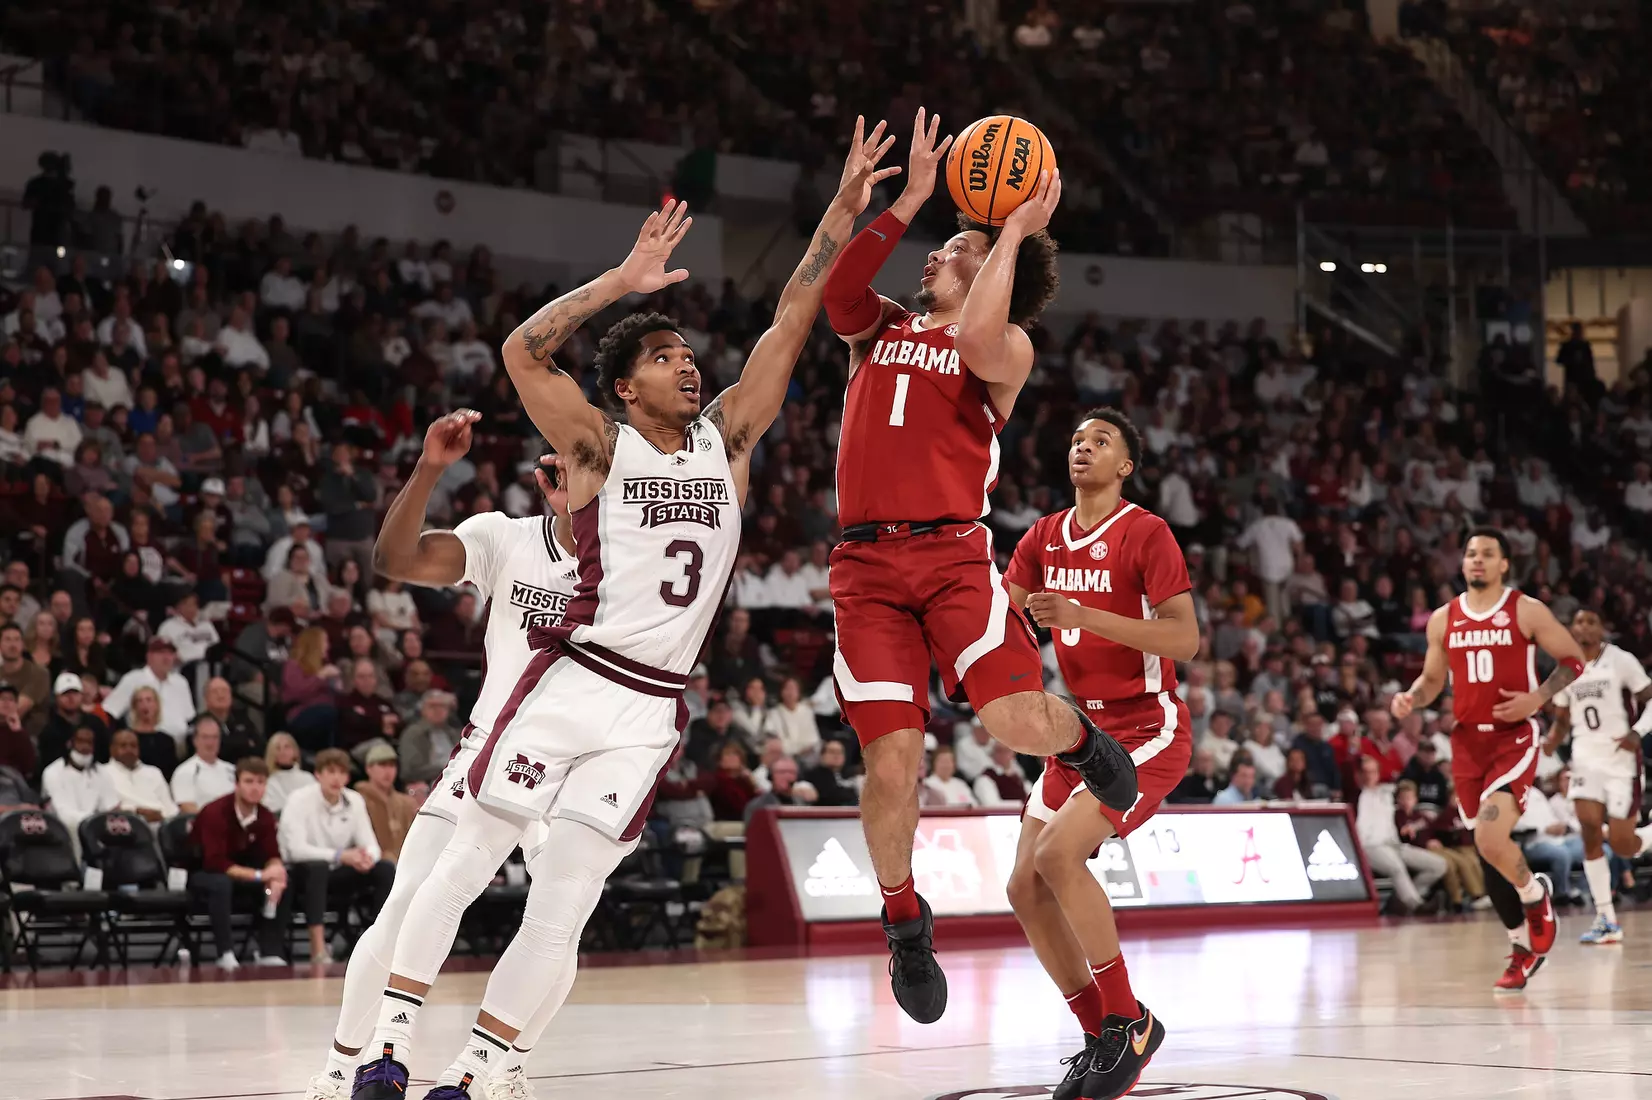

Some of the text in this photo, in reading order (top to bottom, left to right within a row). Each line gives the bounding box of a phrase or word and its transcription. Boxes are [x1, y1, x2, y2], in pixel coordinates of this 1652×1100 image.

[970, 123, 1002, 191] Wilson
[1006, 137, 1031, 191] NCAA
[870, 340, 960, 375] ALABAMA
[889, 373, 910, 427] 1
[622, 479, 729, 501] MISSISSIPPI
[656, 506, 710, 524] STATE
[660, 539, 704, 608] 3
[1044, 565, 1113, 593] LABAMA
[1449, 629, 1513, 648] ALABAMA
[1466, 649, 1494, 683] 10
[1584, 706, 1601, 730] 0
[513, 764, 541, 782] STATE
